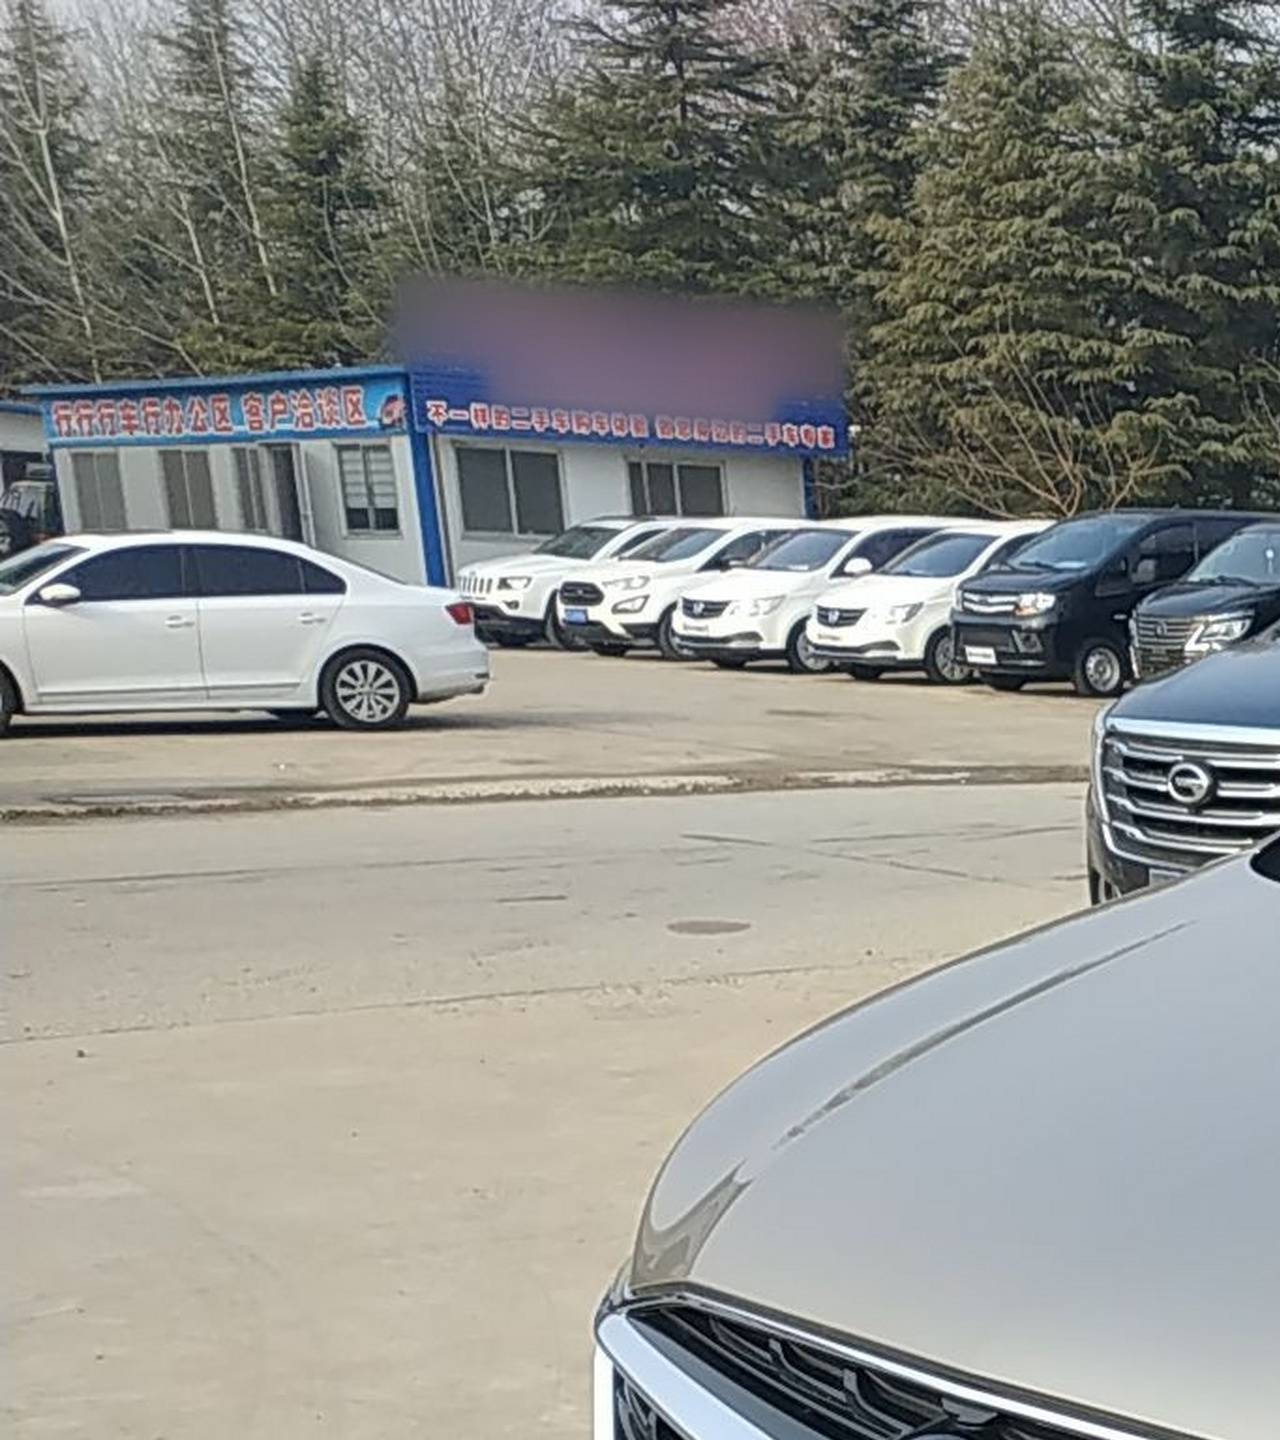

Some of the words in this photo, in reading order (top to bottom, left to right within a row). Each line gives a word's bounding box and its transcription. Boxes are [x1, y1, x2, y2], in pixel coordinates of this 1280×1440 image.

[52, 393, 234, 438] 行行行车行办公区
[241, 385, 367, 433] 客户洽谈区
